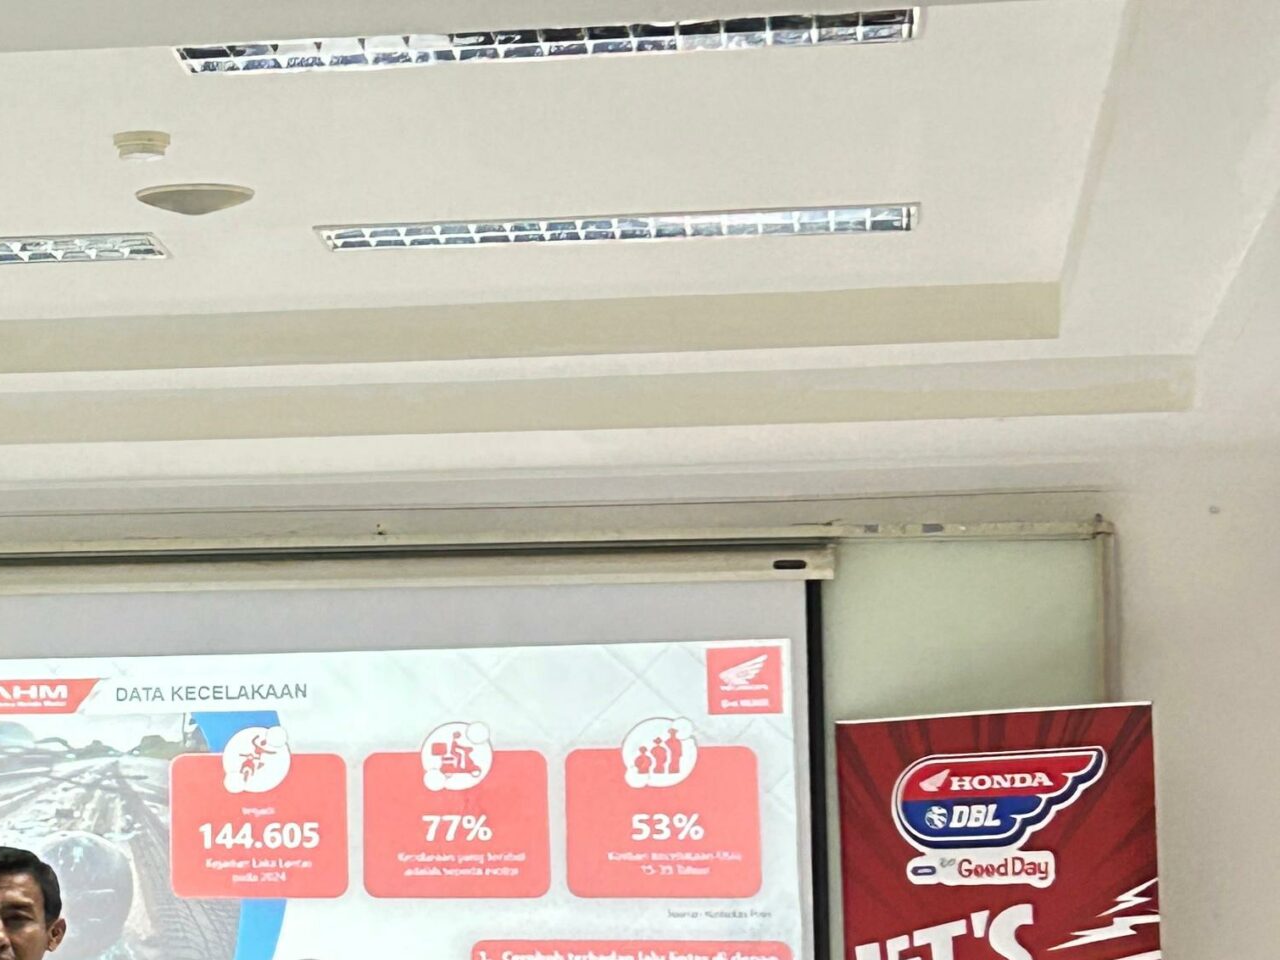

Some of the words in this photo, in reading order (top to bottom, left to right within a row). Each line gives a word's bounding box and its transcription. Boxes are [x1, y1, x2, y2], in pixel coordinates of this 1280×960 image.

[116, 687, 165, 702] DATA
[170, 683, 308, 702] KECELAKAAN
[950, 772, 1054, 791] HONDA
[422, 814, 493, 842] 77%
[631, 813, 705, 841] 53%
[949, 804, 1001, 828] DBL
[199, 822, 320, 850] 144.605
[958, 858, 1009, 878] Good
[1011, 857, 1049, 880] Day
